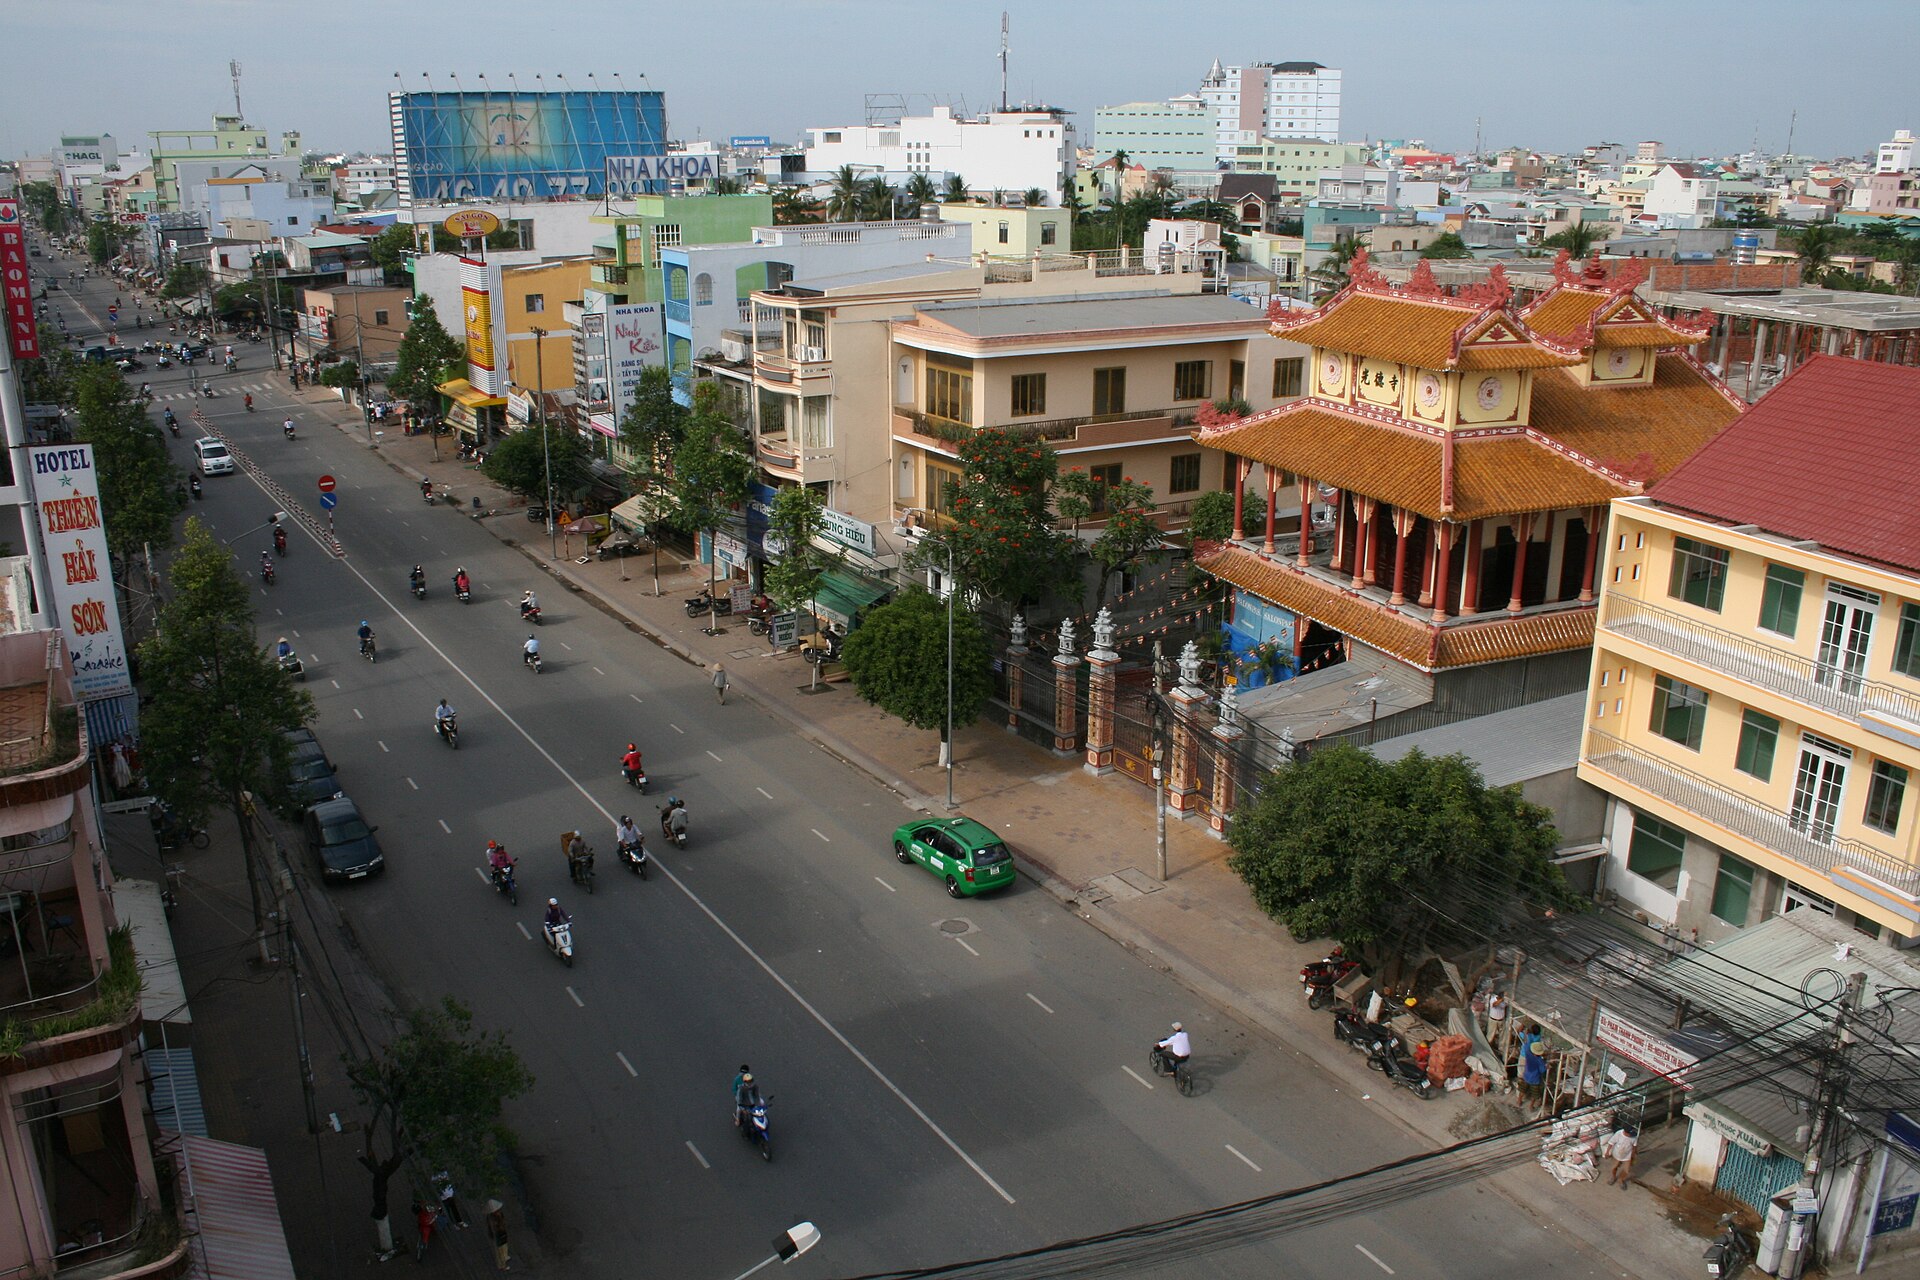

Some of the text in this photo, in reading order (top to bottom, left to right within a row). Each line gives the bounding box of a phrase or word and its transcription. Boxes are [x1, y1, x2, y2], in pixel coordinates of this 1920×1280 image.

[72, 152, 102, 160] HAGL
[608, 156, 713, 180] NHA KHOA
[615, 306, 655, 316] NHA KHOA
[615, 318, 641, 340] Ninh
[34, 448, 91, 474] HOTEL
[42, 488, 100, 535] THIÊN
[845, 527, 866, 545] HIẾU
[62, 538, 100, 586] HẢI
[71, 597, 109, 637] SƠN
[70, 646, 123, 676] Karaoke
